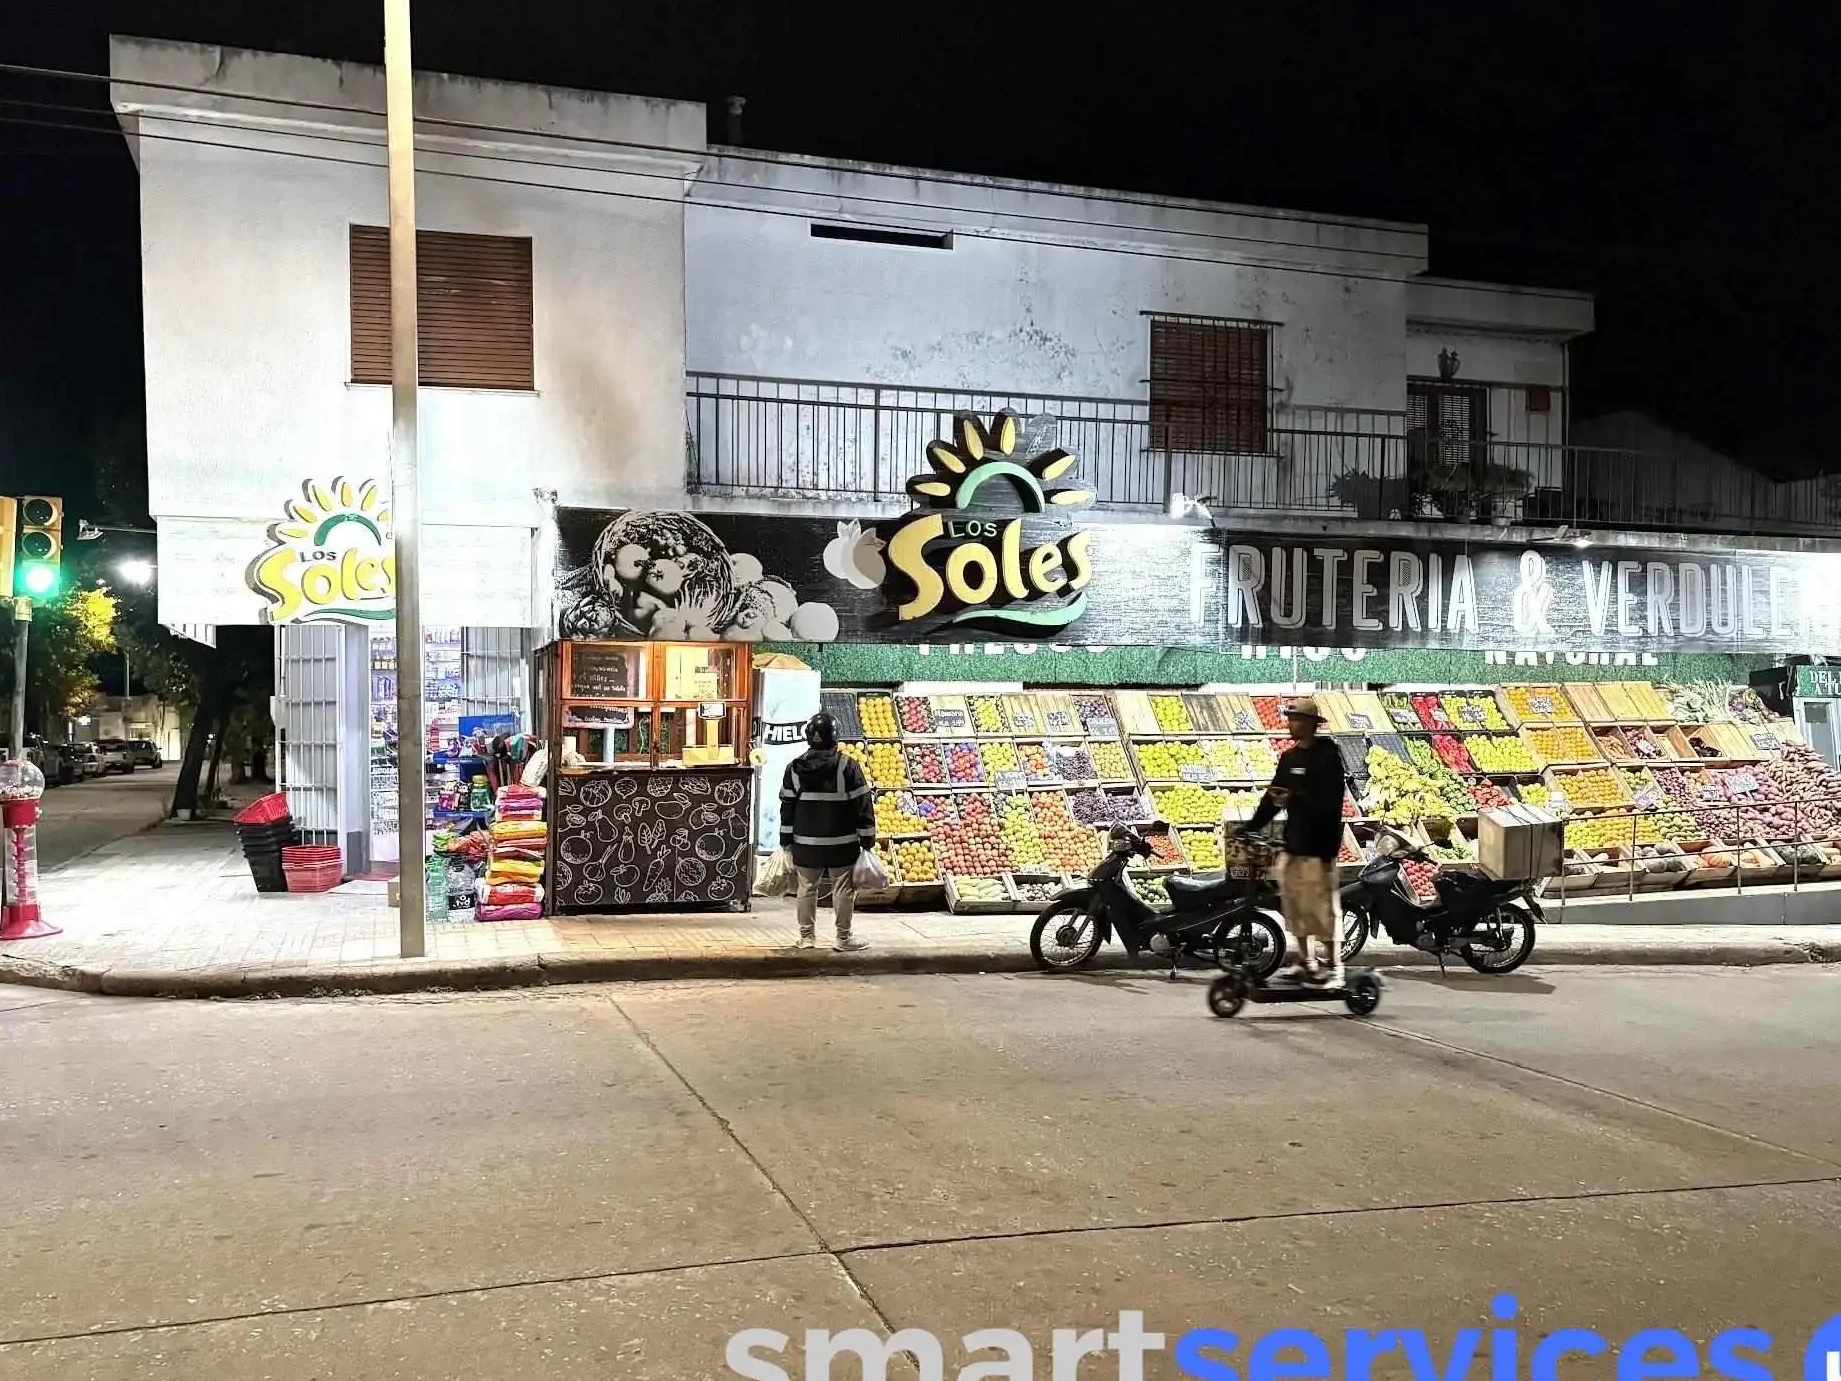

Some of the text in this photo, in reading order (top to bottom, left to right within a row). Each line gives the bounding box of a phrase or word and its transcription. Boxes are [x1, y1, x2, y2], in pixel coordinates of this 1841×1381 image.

[300, 550, 337, 563] LOS
[948, 519, 999, 538] LOS
[888, 513, 1093, 621] Soles
[1189, 543, 1812, 639] FRUTERIA & VERDULE
